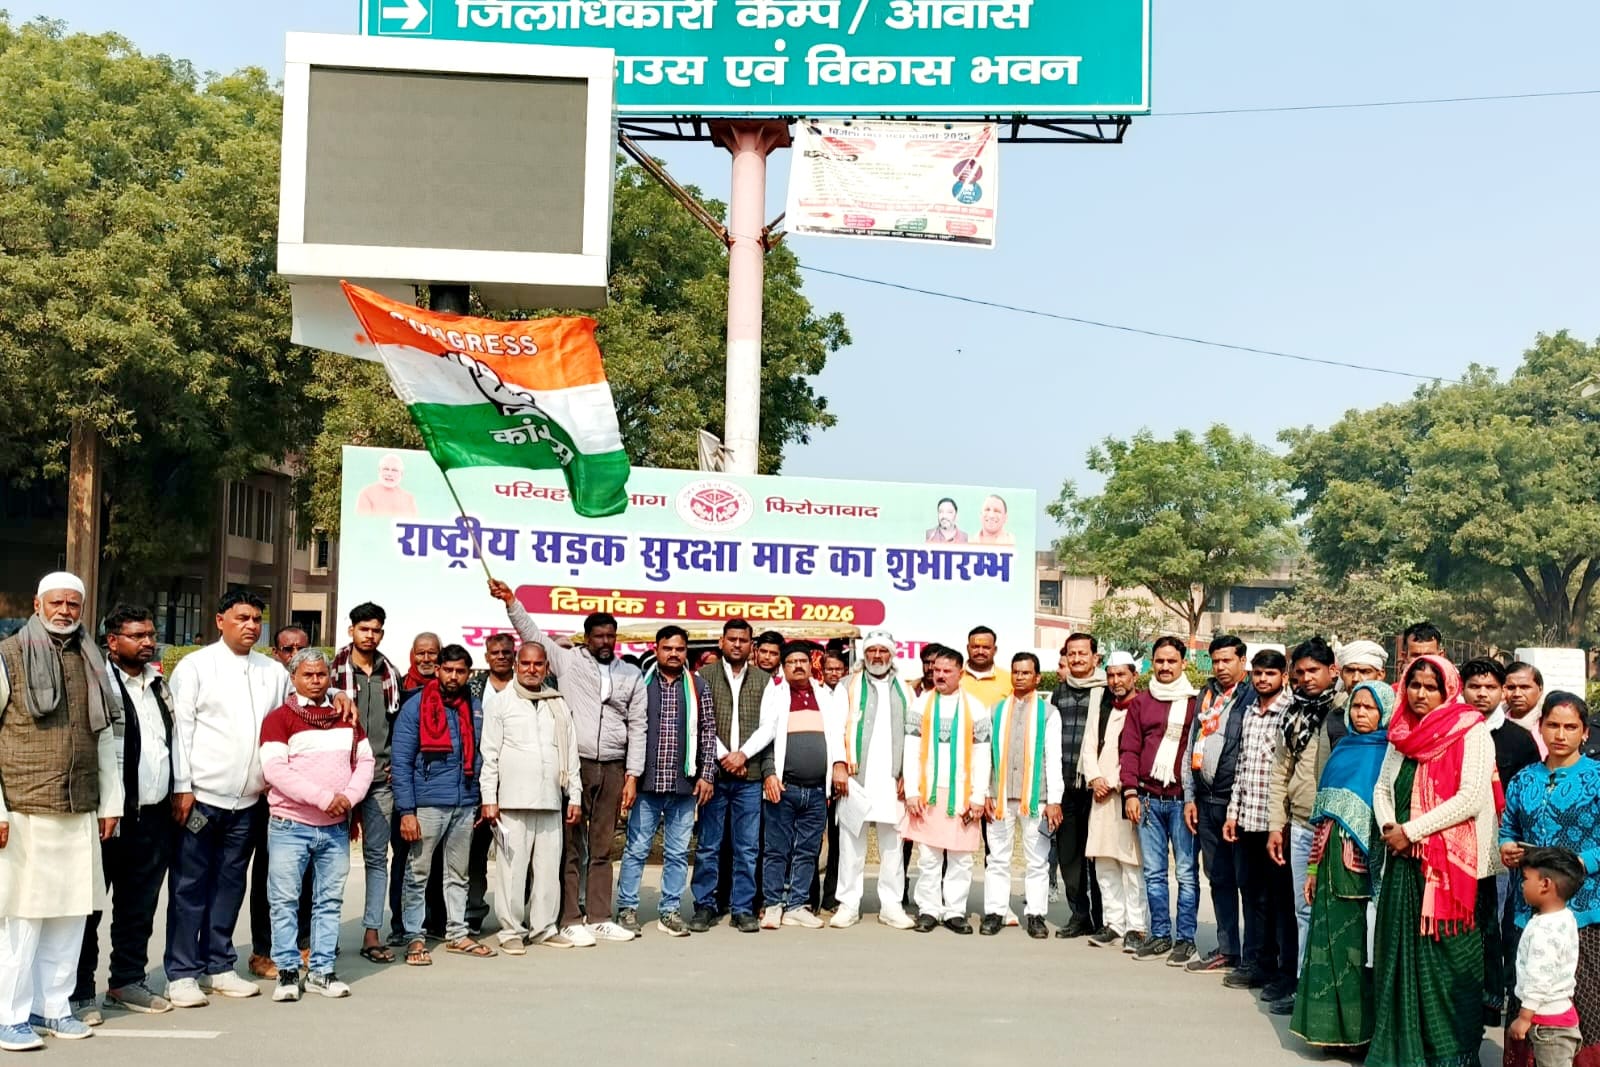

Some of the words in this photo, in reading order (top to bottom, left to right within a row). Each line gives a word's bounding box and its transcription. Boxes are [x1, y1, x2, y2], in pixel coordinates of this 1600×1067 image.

[885, 0, 1034, 29] आवास
[615, 55, 708, 85] ाउस
[723, 39, 789, 88] एवं
[805, 43, 955, 87] विकास
[970, 55, 1082, 86] भवन
[495, 481, 572, 502] परिवह
[396, 515, 519, 568] राष्ट्रीय
[531, 529, 627, 576] सड़क
[640, 534, 742, 582] सुरक्षा
[752, 541, 819, 575] माह
[828, 545, 877, 578] का
[886, 548, 1013, 591] शुभारम्भ
[549, 586, 647, 615] दिनांक
[677, 599, 687, 616] 1
[697, 596, 795, 621] जनवरी
[801, 602, 855, 622] 2026
